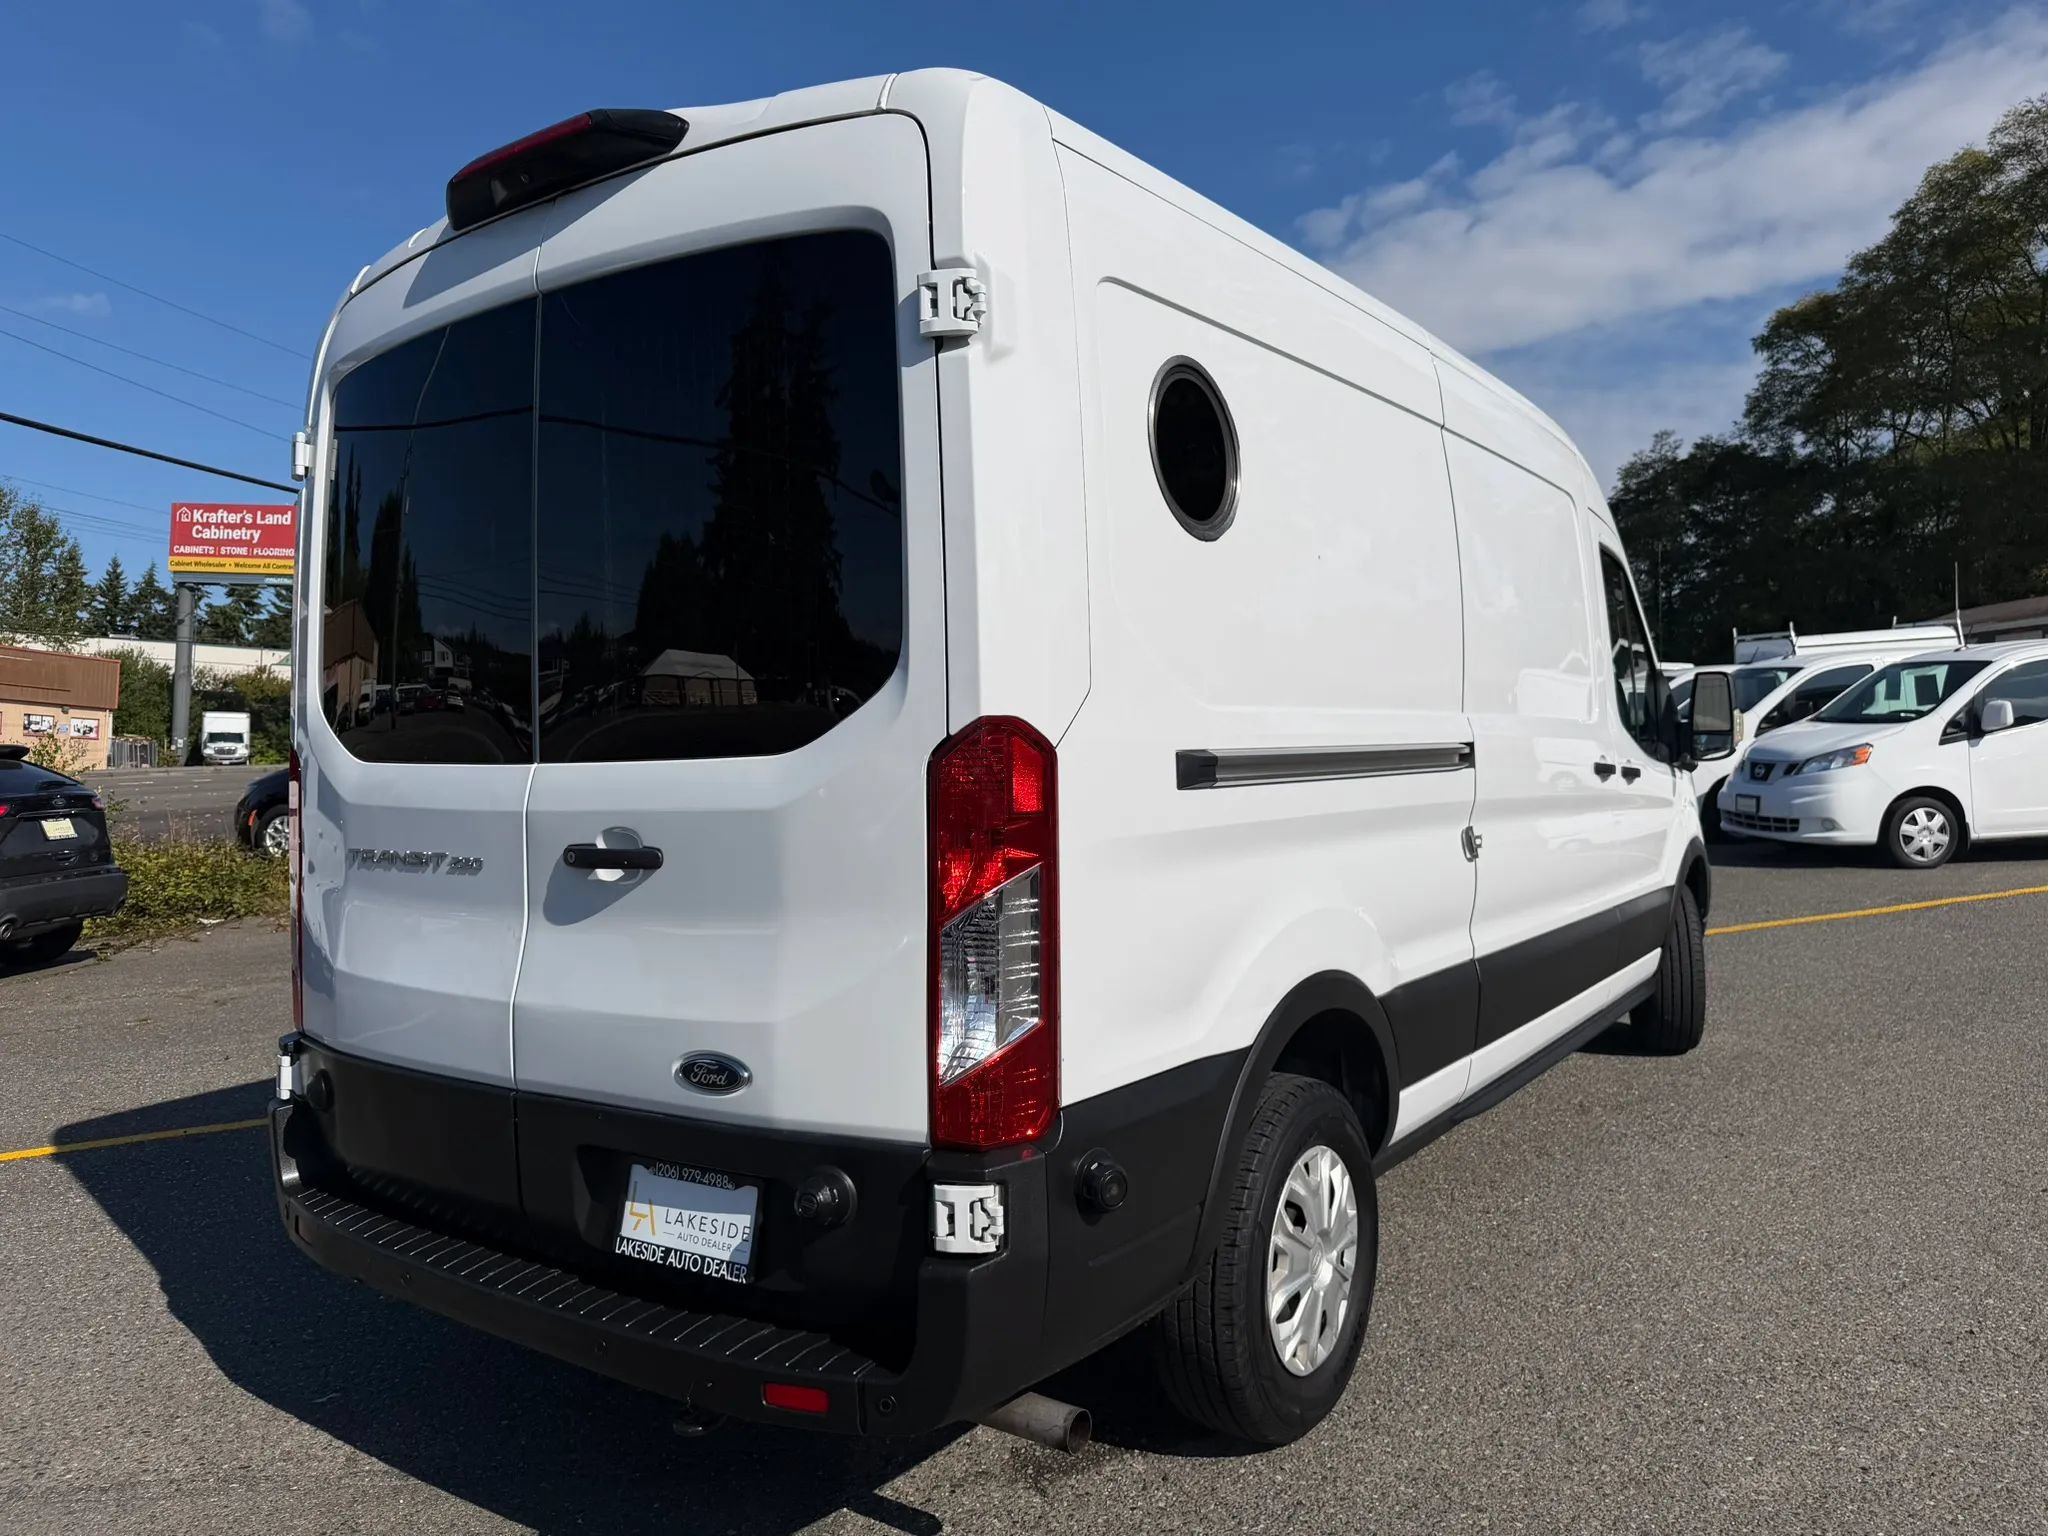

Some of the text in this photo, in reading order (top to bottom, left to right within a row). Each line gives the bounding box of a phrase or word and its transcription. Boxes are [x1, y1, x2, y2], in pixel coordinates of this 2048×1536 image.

[193, 509, 292, 525] Krafter's Land
[192, 525, 261, 543] Cabinetry
[173, 545, 295, 557] CABINETS STONE FLOORING
[170, 560, 193, 568] Cabinet
[194, 560, 227, 569] Wholesaler
[234, 561, 262, 569] Welcome
[262, 562, 271, 570] All
[348, 848, 449, 868] TRANSIT
[690, 1062, 729, 1085] Ford
[655, 1161, 730, 1189] (206) 979-4988
[665, 1208, 751, 1242] LAKESIDE
[676, 1231, 733, 1252] AUTO DEALER
[615, 1236, 748, 1284] LAKESIDE AUTO DEALER
